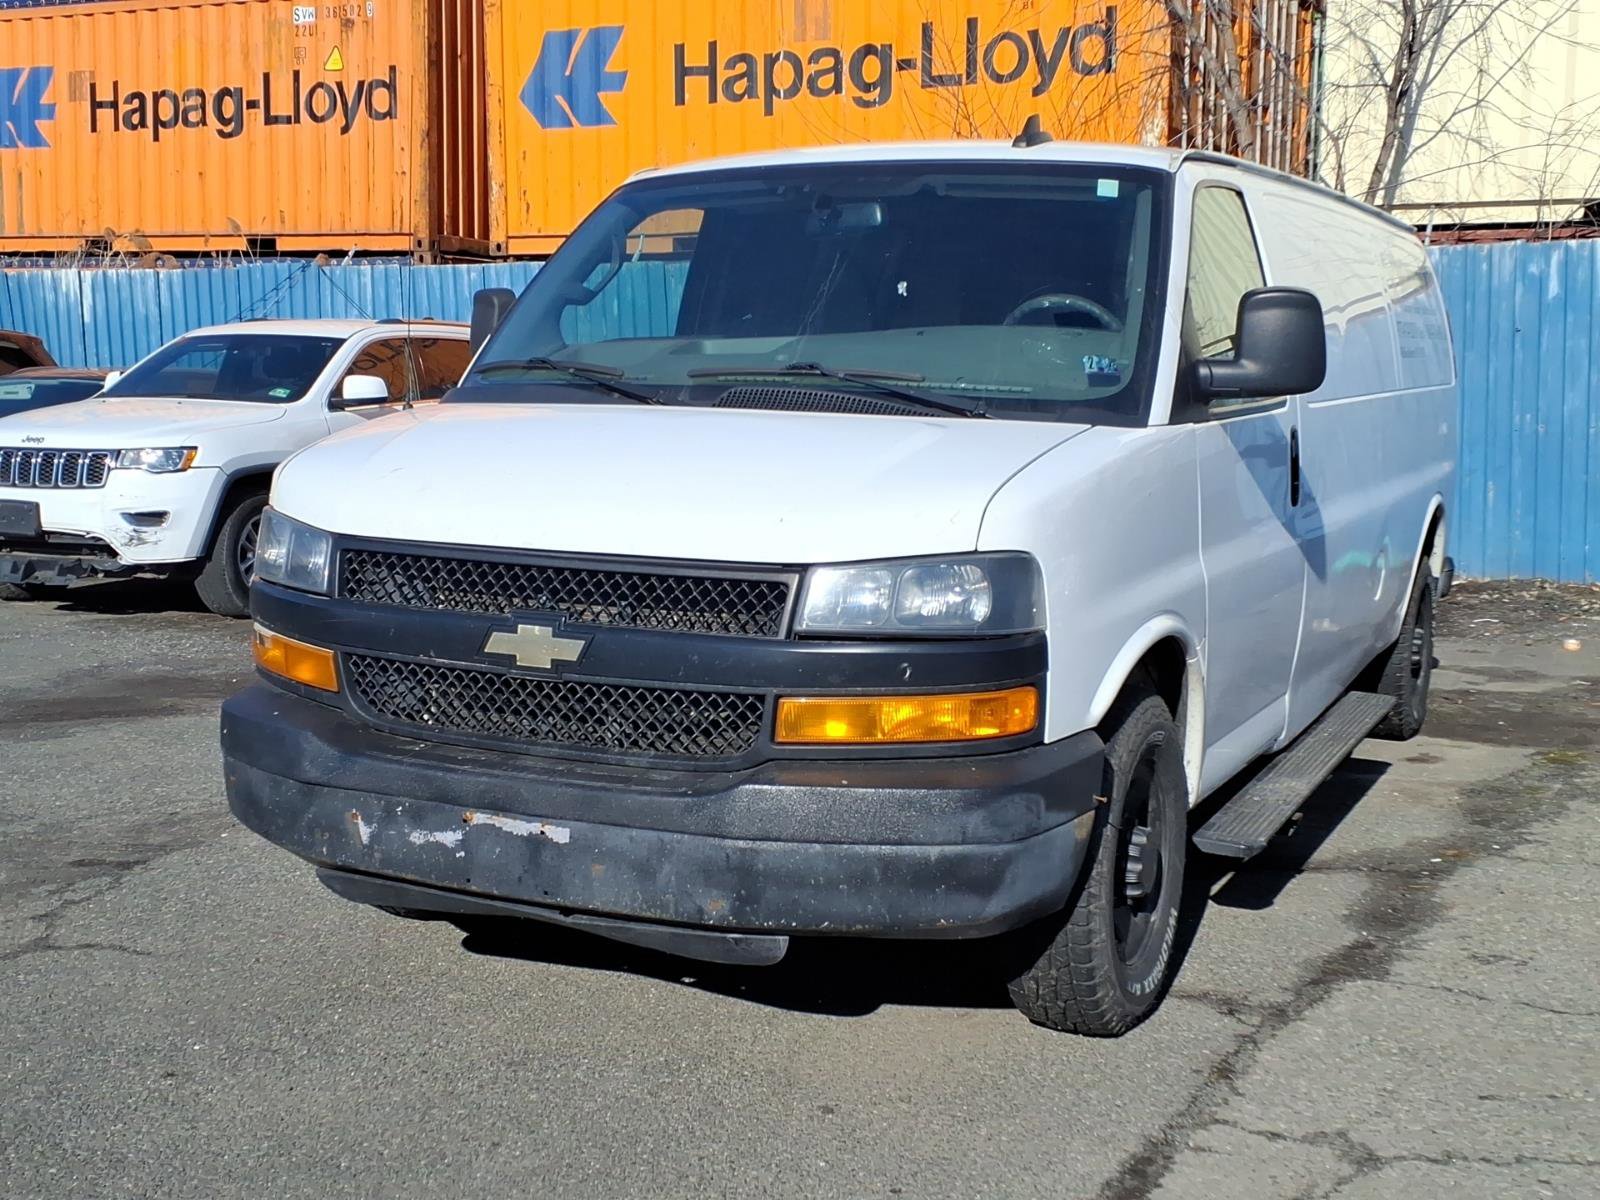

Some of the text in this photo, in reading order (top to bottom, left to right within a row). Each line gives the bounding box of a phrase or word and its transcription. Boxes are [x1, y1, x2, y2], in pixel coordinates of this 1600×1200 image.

[673, 5, 1118, 117] Hapag-Lloyd
[89, 65, 398, 142] Hapag-Lloyd
[21, 434, 45, 445] Jeep
